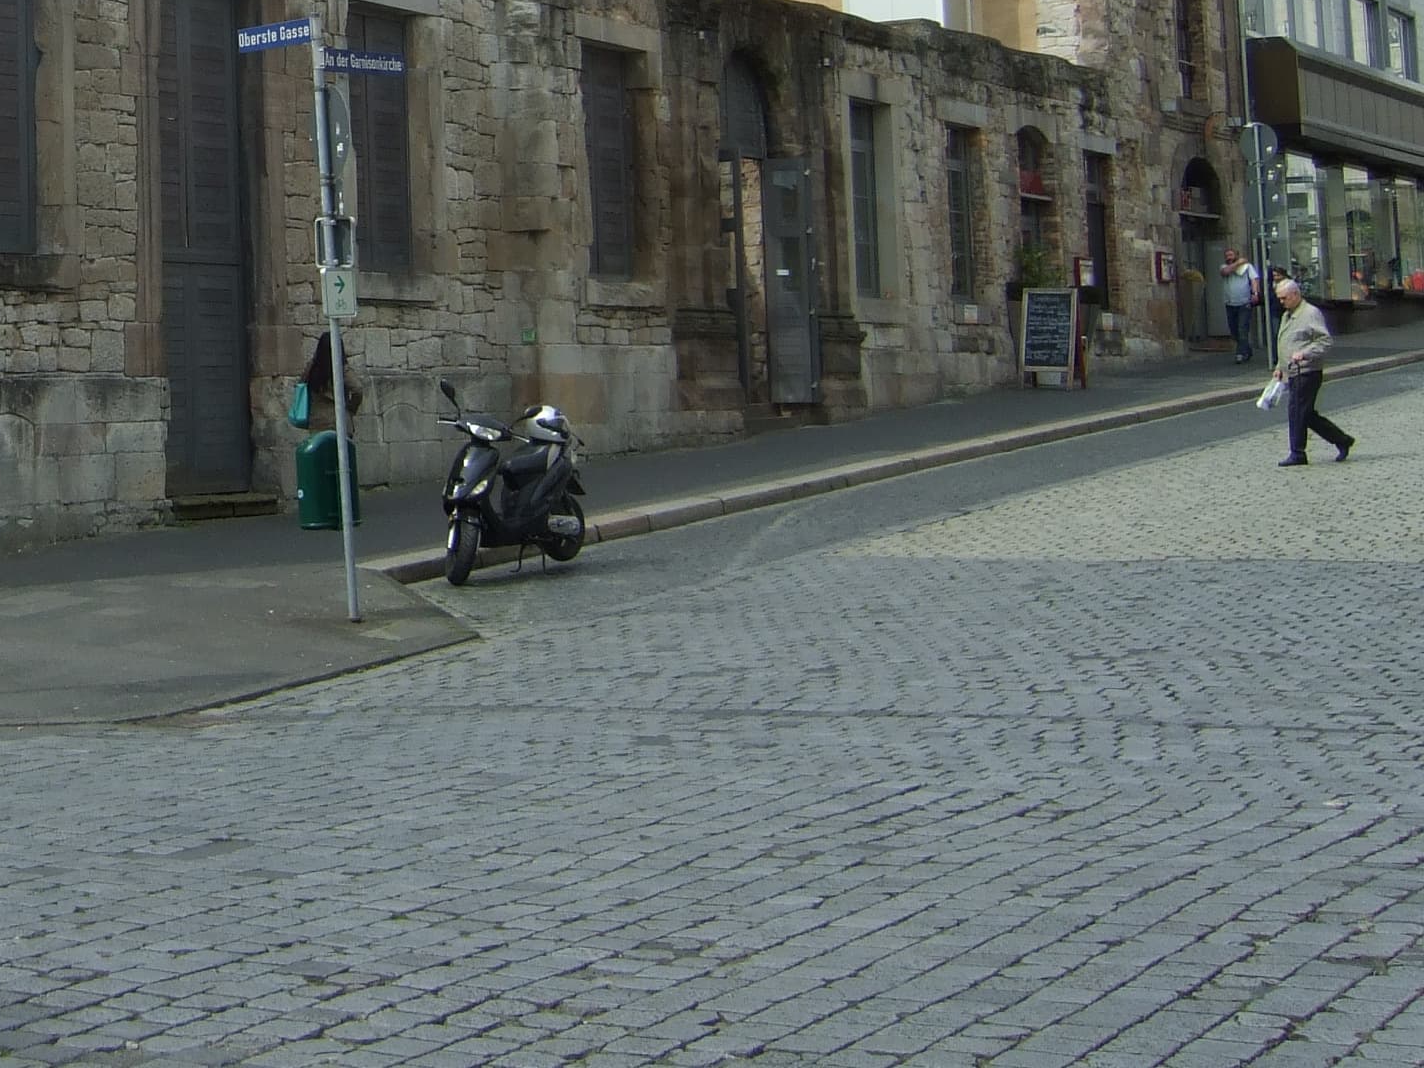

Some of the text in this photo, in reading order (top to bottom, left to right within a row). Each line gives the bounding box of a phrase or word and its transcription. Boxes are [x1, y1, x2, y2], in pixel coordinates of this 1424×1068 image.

[238, 24, 310, 48] Oberste Gasse
[325, 52, 402, 72] An der Garnisonkirche
